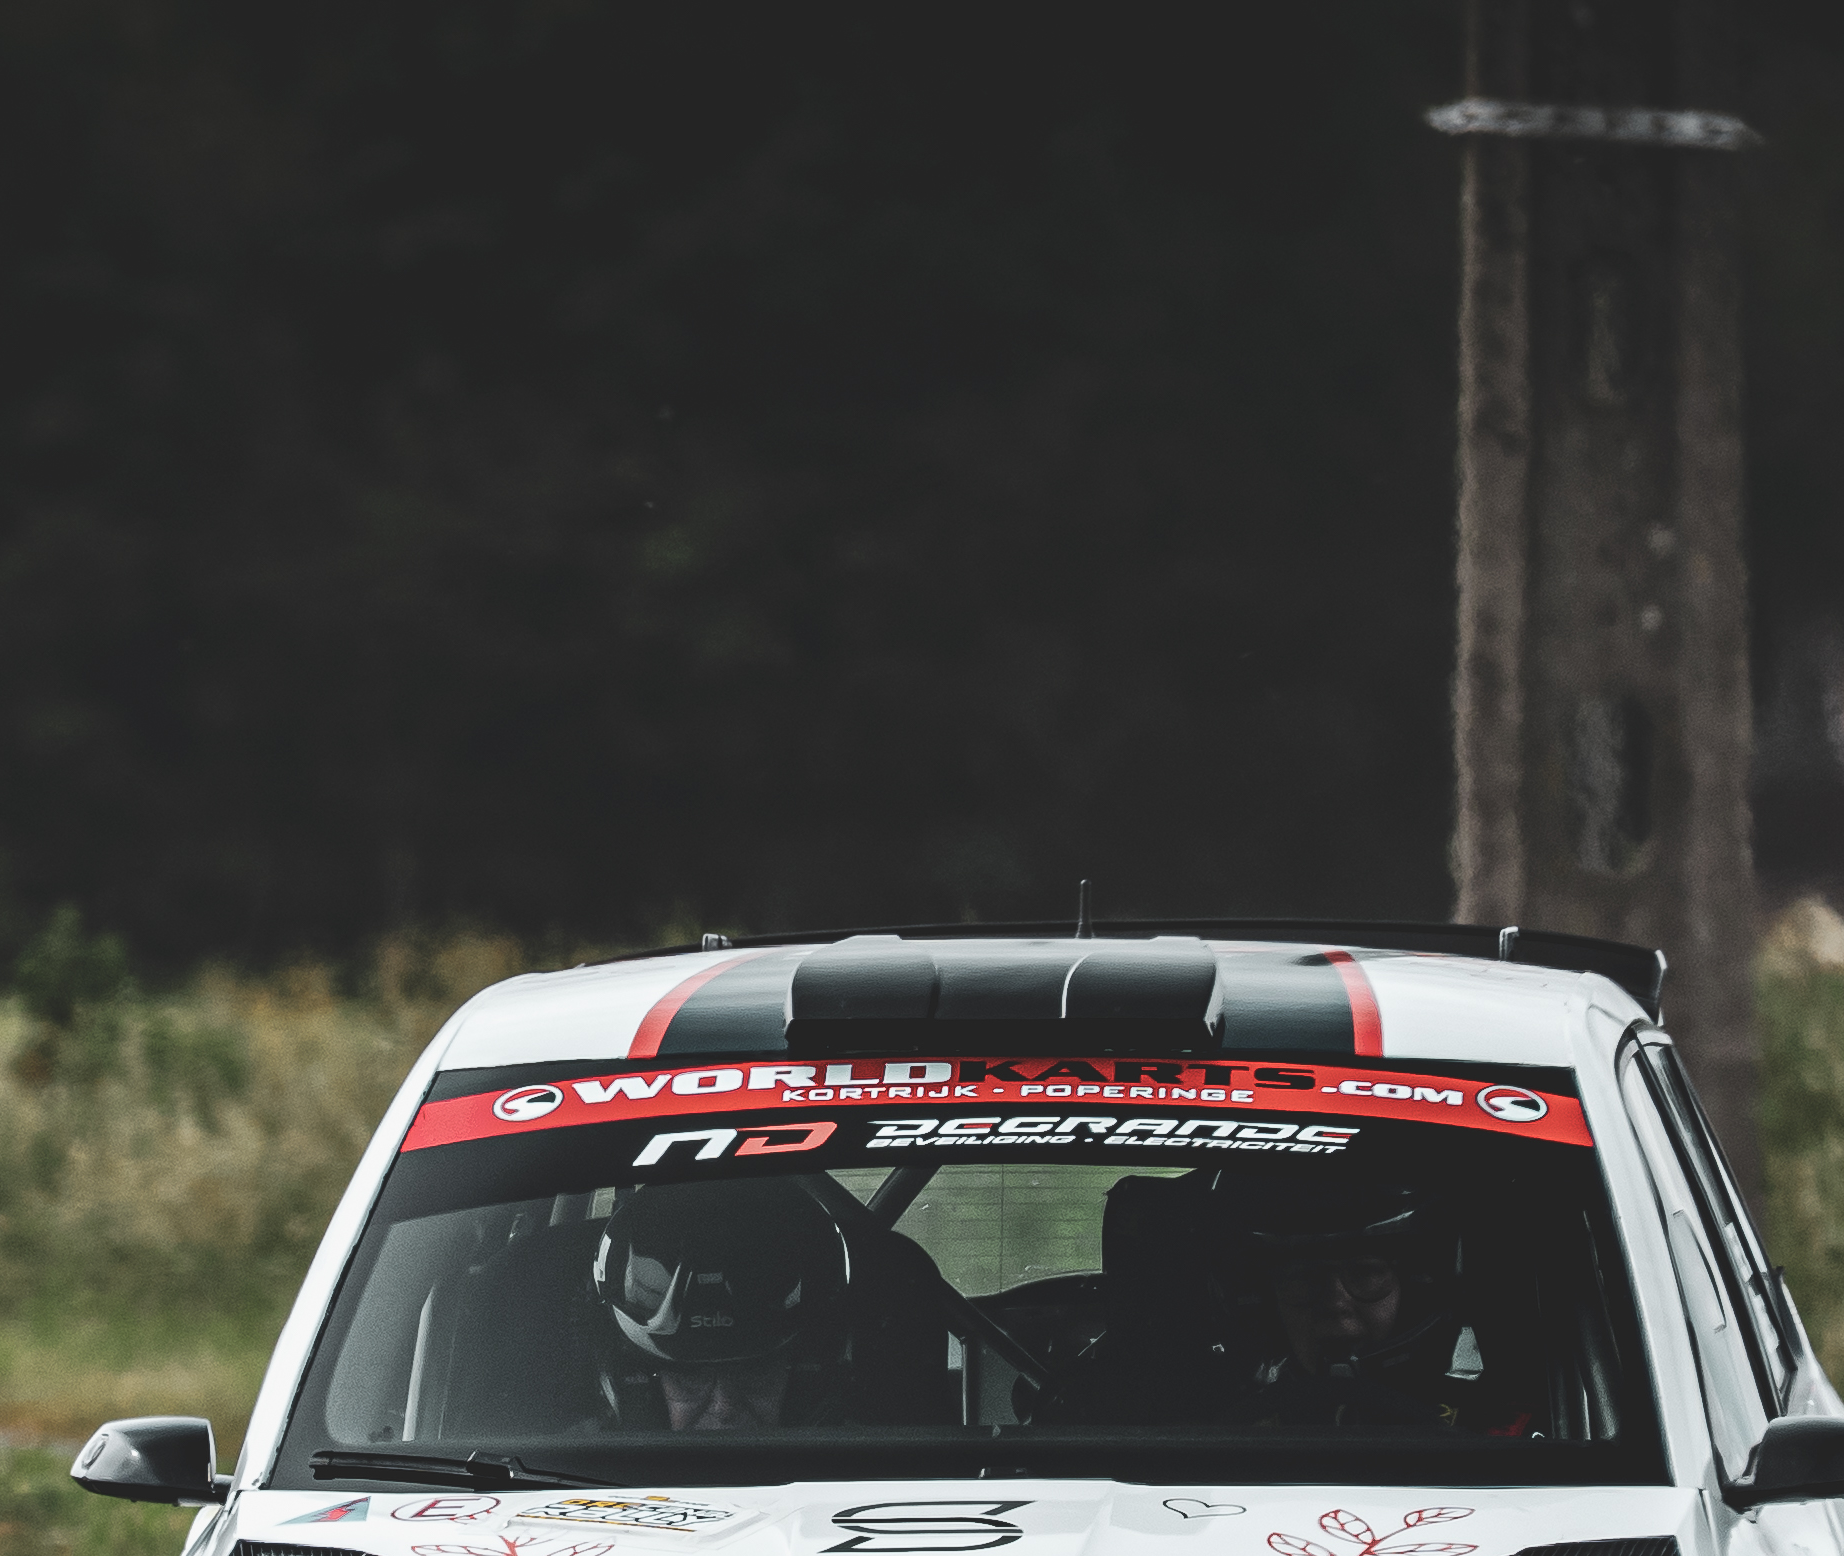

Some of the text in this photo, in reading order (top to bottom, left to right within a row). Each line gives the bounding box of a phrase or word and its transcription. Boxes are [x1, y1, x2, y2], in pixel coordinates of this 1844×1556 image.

[781, 1084, 1254, 1103] KORTRIJK POPERINGE
[866, 1116, 1360, 1144] DEGRANDE
[866, 1135, 1346, 1153] BEVEILIGING ELECTRICITEIT
